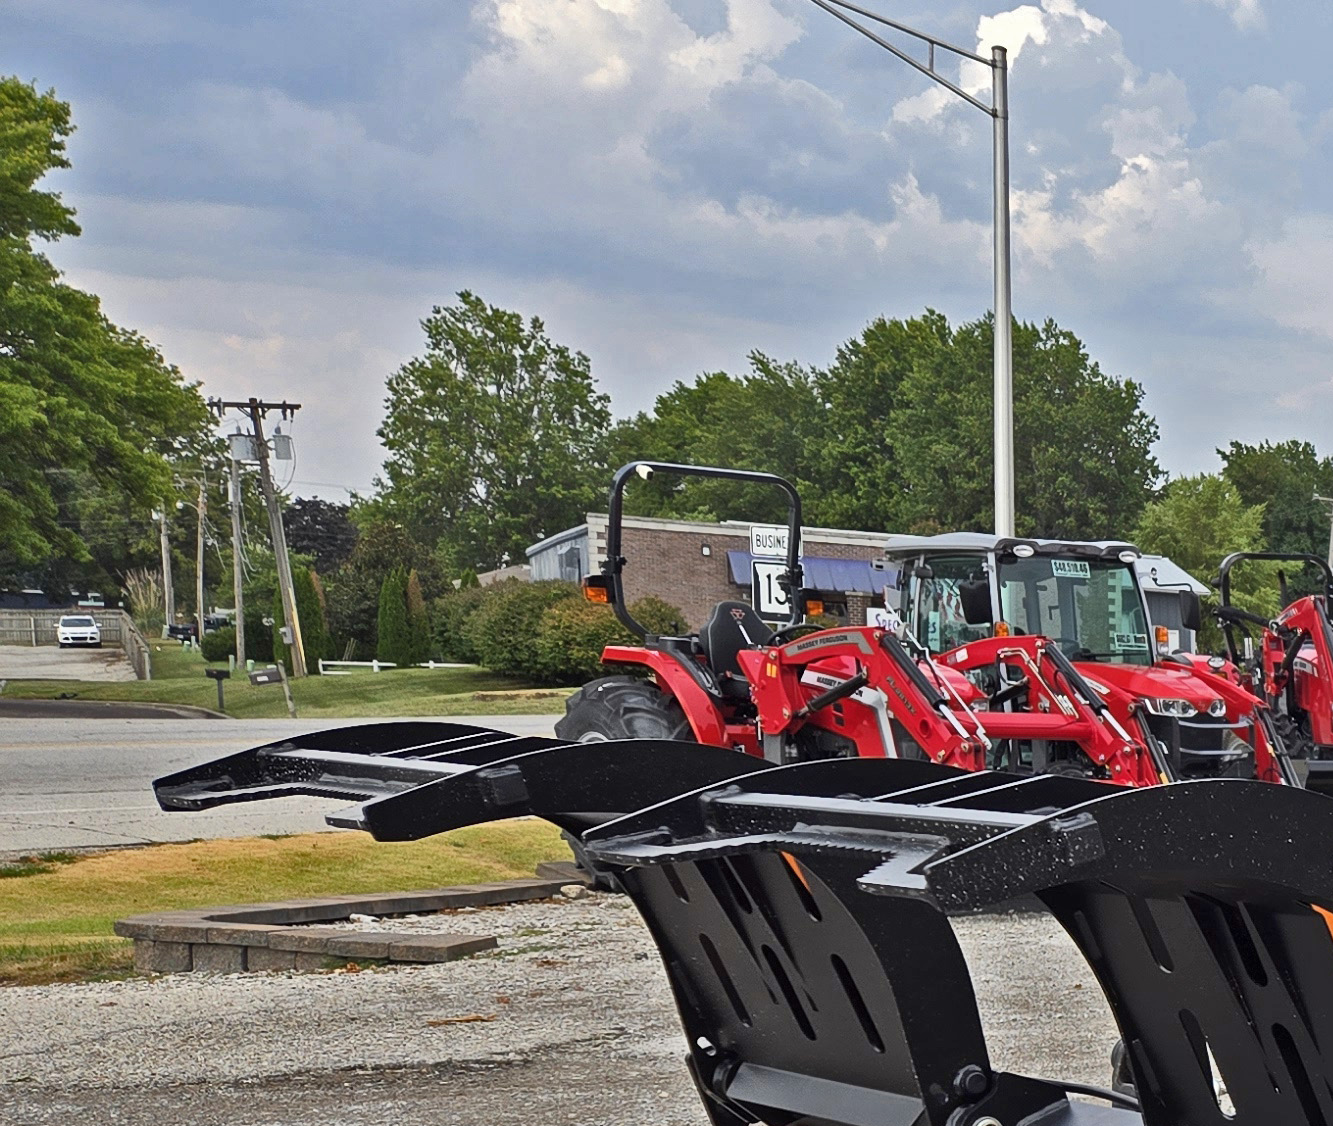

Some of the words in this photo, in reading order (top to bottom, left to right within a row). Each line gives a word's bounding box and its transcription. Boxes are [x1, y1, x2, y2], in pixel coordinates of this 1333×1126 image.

[756, 534, 787, 549] BUSINE
[797, 639, 819, 650] MASSEY
[820, 635, 848, 645] FERGUSON
